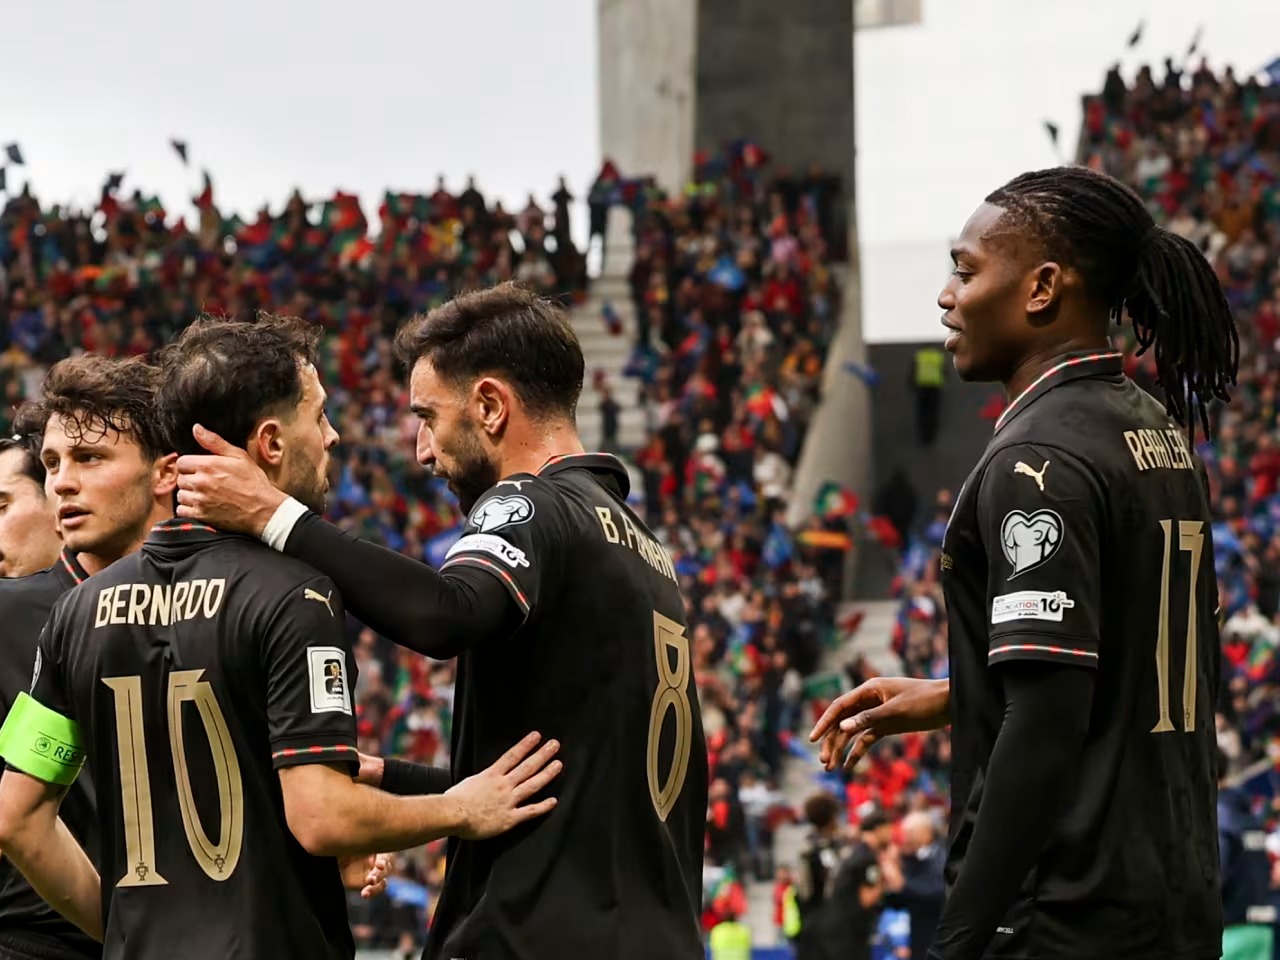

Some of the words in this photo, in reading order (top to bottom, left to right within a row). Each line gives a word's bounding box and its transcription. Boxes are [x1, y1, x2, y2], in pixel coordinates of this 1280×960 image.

[94, 578, 226, 628] BERNRDO
[1150, 519, 1204, 733] 17
[101, 668, 244, 887] 10
[647, 609, 693, 823] 8
